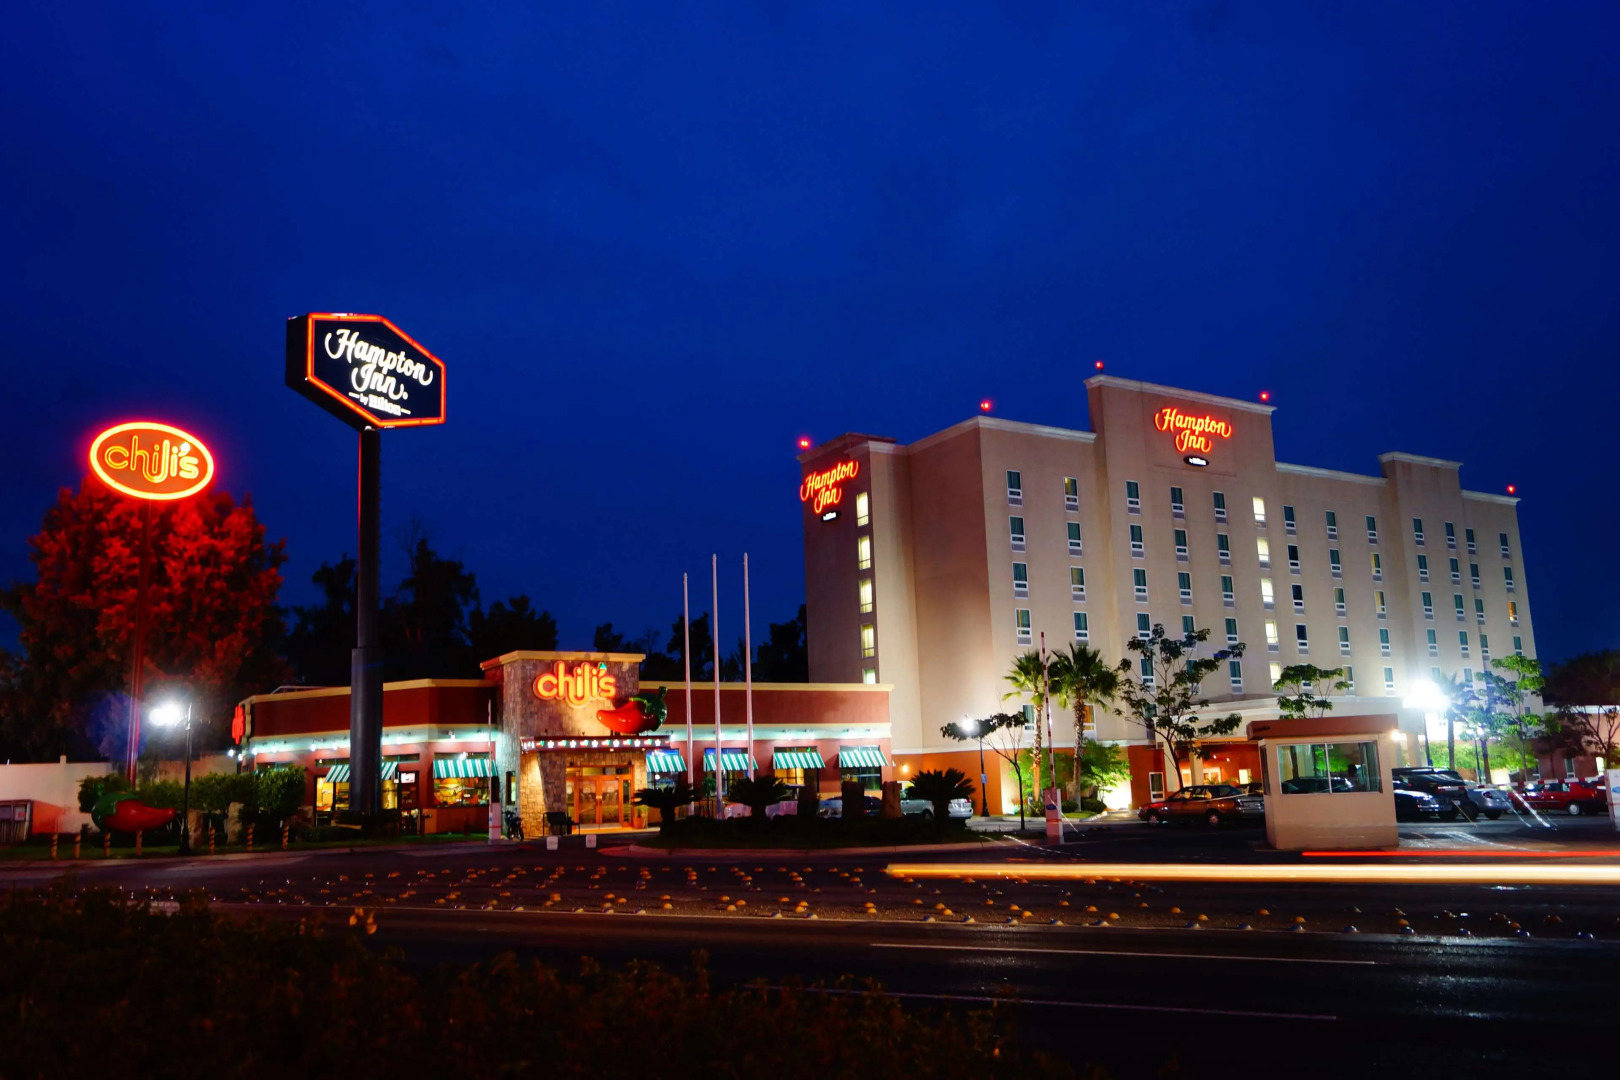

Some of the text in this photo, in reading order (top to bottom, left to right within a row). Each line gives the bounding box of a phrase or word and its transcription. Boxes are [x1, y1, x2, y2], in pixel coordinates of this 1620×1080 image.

[324, 328, 434, 386] Hampton
[1154, 408, 1232, 438] Hampton
[1175, 429, 1212, 453] Inn
[104, 435, 200, 484] chili's
[800, 460, 859, 502] Hampton
[814, 486, 842, 514] Inn
[535, 660, 617, 707] chili's
